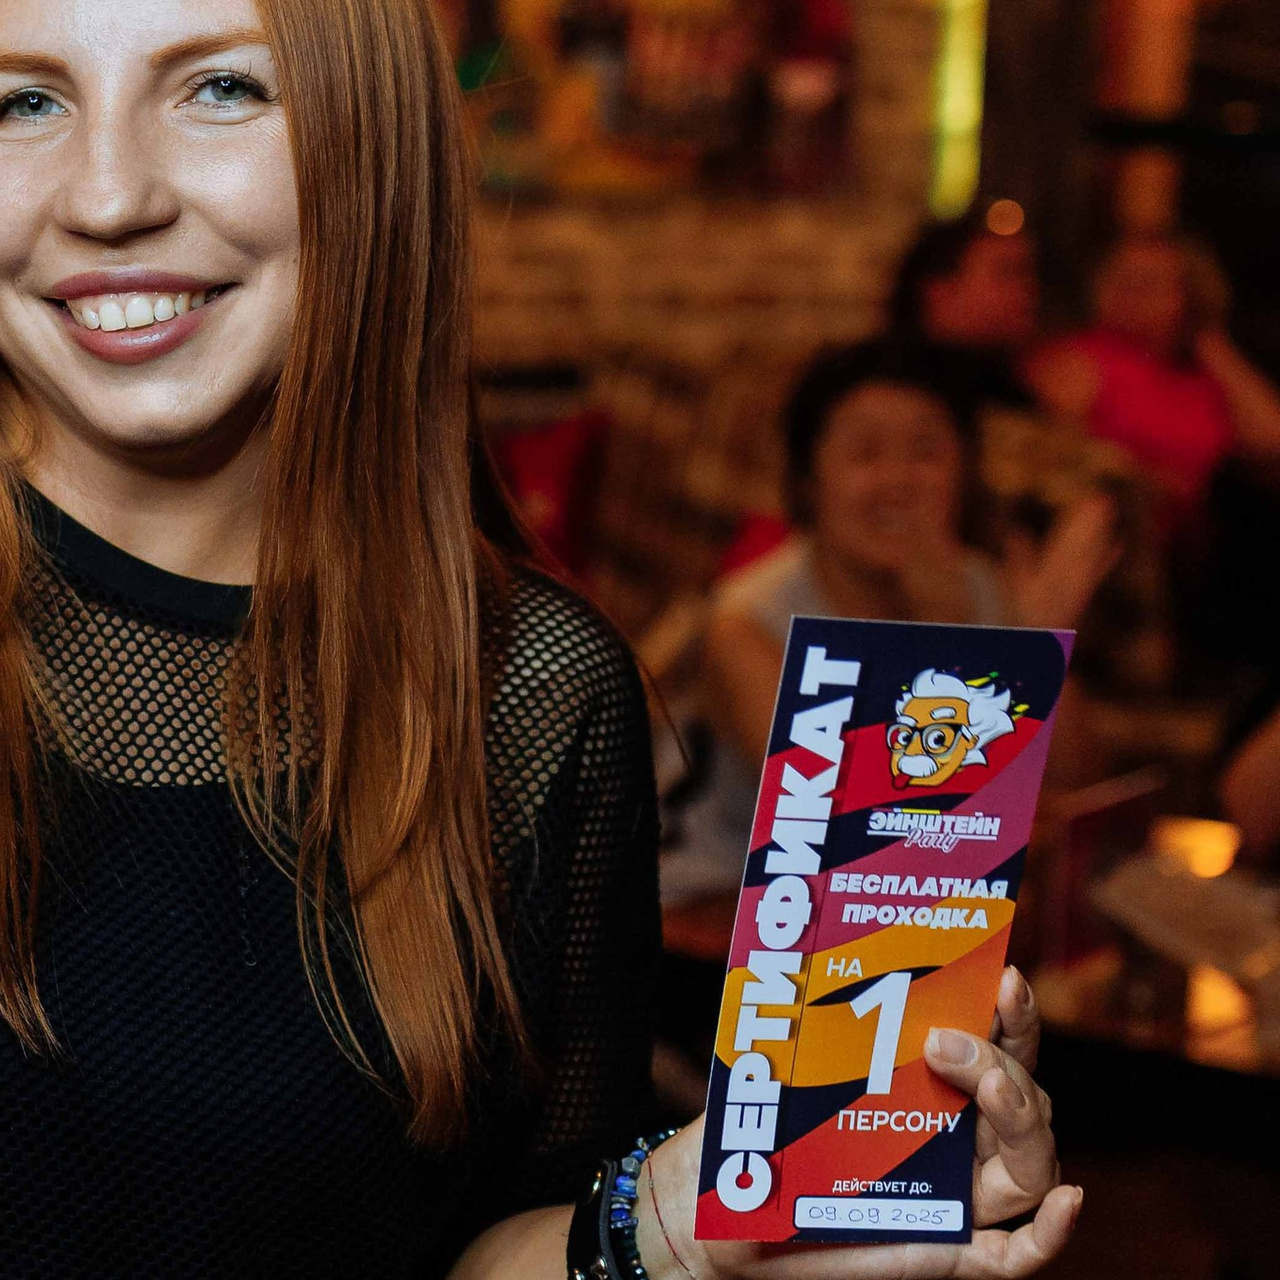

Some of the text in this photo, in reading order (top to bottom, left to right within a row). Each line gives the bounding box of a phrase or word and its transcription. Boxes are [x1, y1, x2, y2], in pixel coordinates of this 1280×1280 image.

[868, 807, 1002, 836] ЭЙНШТЕЙН
[904, 827, 959, 853] Party
[829, 872, 1009, 900] БЕСПЛАТНАЯ
[717, 646, 862, 1213] СЕРТИФИКАТ
[841, 903, 989, 930] ПРОХОДКА
[826, 957, 863, 978] НА
[850, 971, 912, 1095] 1
[837, 1109, 962, 1133] ПЕРСОНУ
[832, 1177, 933, 1195] ДЕЙСТВУЕТ ДО:
